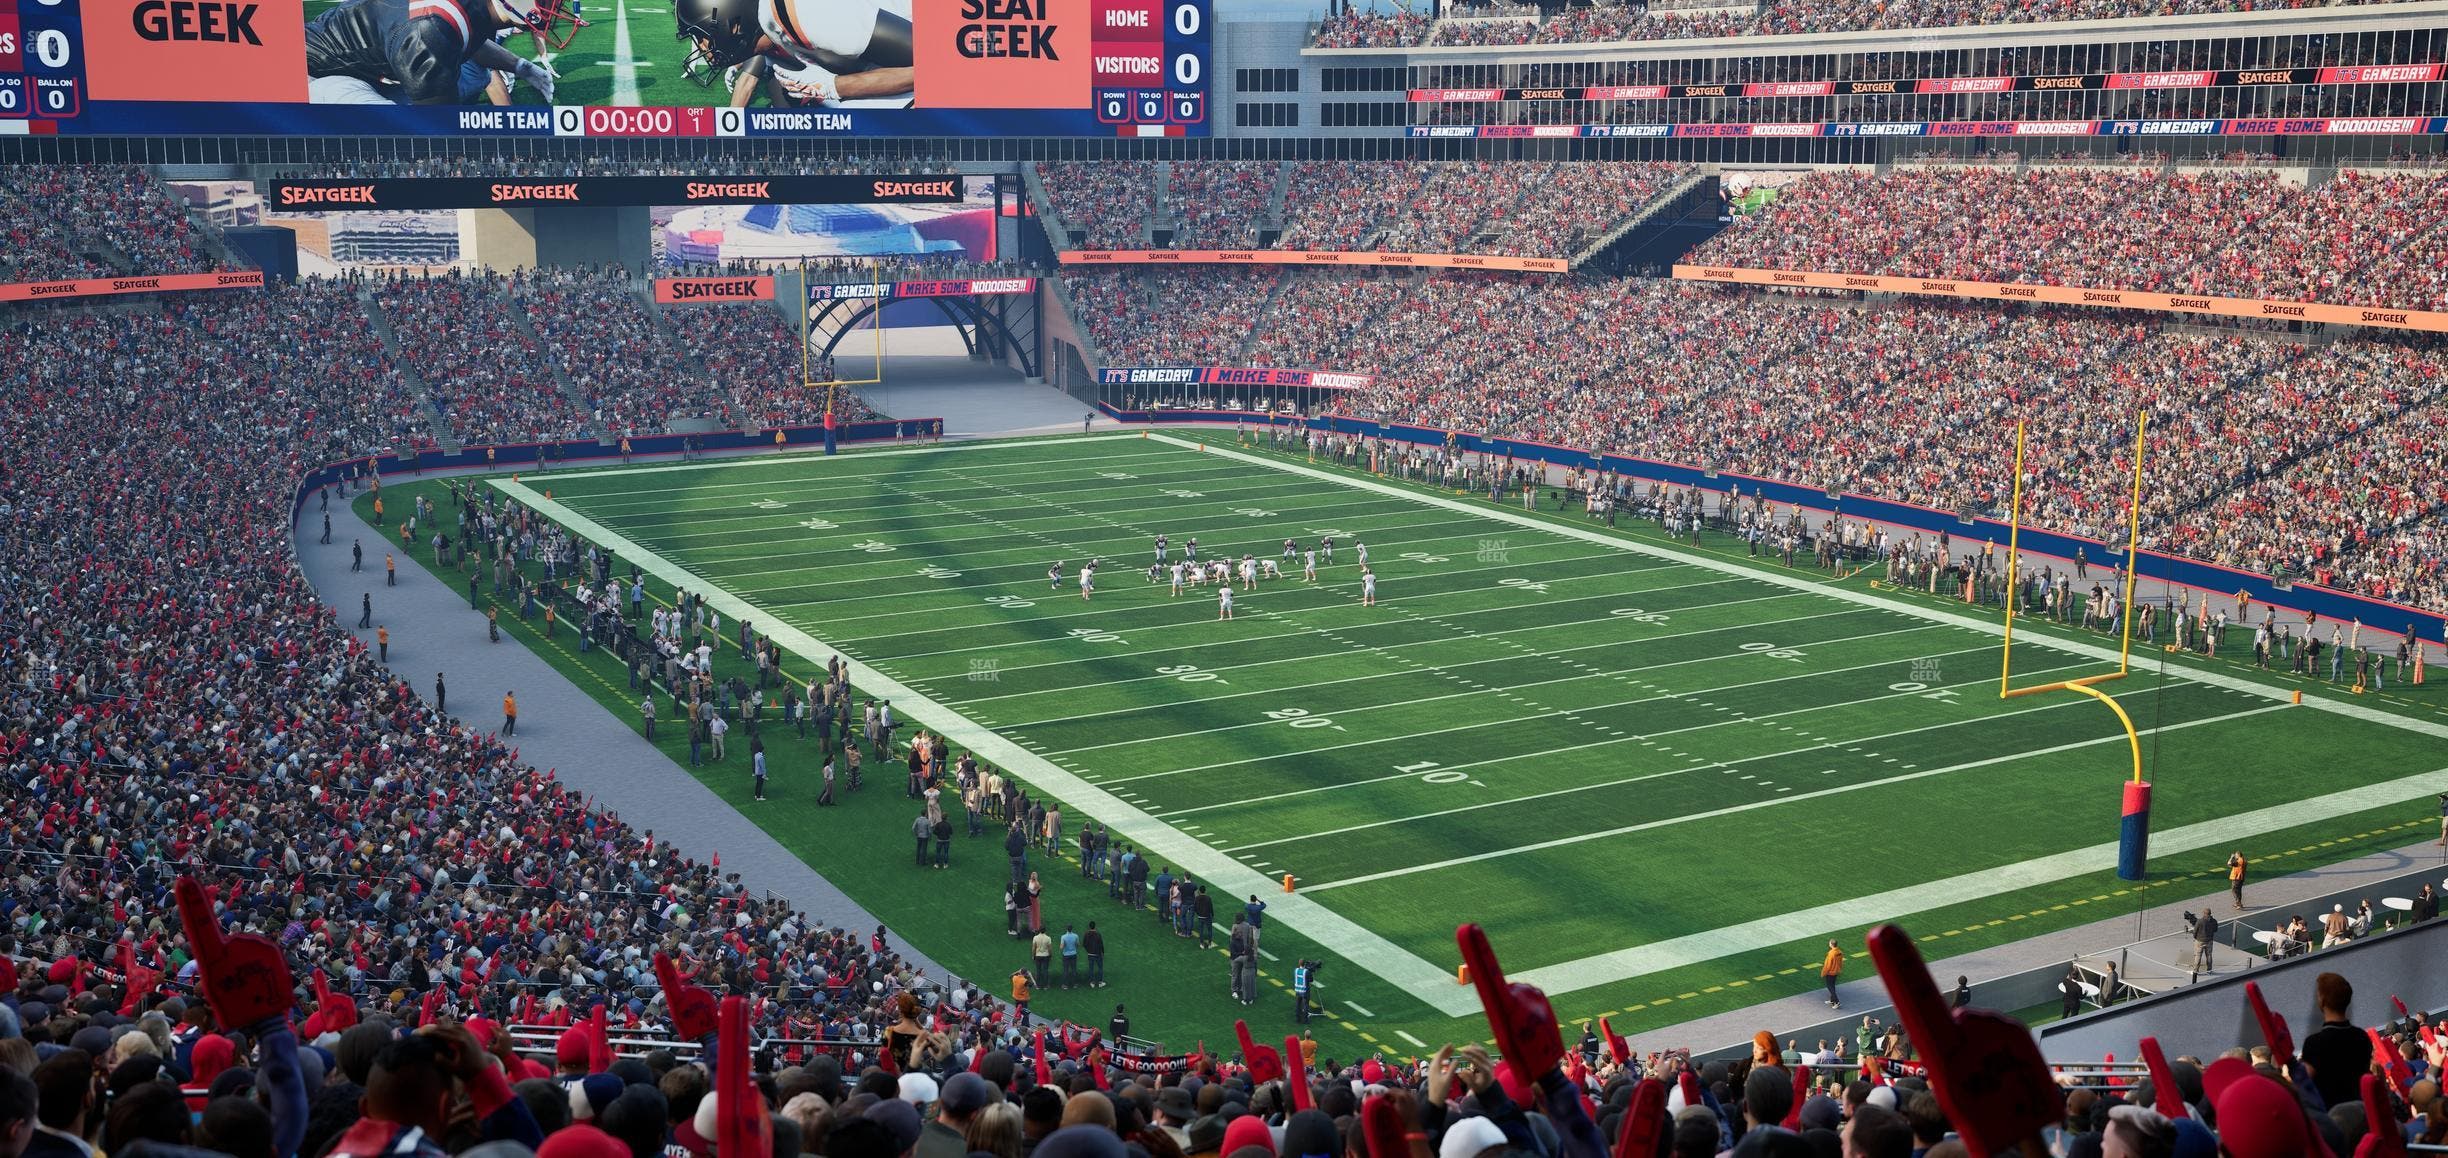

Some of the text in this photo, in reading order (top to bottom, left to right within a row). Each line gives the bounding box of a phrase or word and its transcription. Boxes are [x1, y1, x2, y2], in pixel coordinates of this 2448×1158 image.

[132, 0, 264, 47] GEEK
[1105, 9, 1149, 27] HOME
[1174, 3, 1200, 35] 0
[37, 29, 70, 68] 0
[956, 24, 1060, 61] GEEK
[1094, 56, 1160, 74] VISITORS
[1175, 53, 1201, 84] 0
[2143, 73, 2204, 86] GAMEDAY!
[2238, 71, 2292, 84] SEATGEEK
[2361, 67, 2431, 81] GAMEDAY!
[7, 78, 20, 86] GO
[38, 79, 73, 87] BALL ON
[1851, 82, 1896, 94] SEATGEEK
[1951, 79, 2005, 91] GAMEDAY!
[2033, 77, 2083, 89] SEATGEEK
[1443, 90, 1495, 101] GAMEDAY!
[1521, 88, 1565, 100] SEATGEEK
[1614, 87, 1660, 99] GAMEDAY!
[1685, 86, 1726, 97] SEATGEEK
[1776, 83, 1826, 95] GAMEDAY!
[0, 89, 16, 109] 0
[48, 90, 65, 109] 0
[687, 107, 705, 117] QRT
[1108, 101, 1120, 117] 0
[1144, 101, 1156, 117] 0
[1180, 101, 1192, 117] 0
[459, 111, 550, 130] HOME TEAM
[560, 109, 579, 132] 0
[590, 109, 673, 133] 00:00
[692, 118, 700, 133] 1
[722, 110, 740, 133] 0
[751, 113, 852, 130] VISITORS TEAM
[2234, 121, 2279, 132] MAKE
[2283, 120, 2325, 132] SOME
[1430, 127, 1475, 137] GAMEDAY!
[1612, 126, 1669, 136] GAMEDAY!
[1684, 126, 1715, 136] MAKE
[1719, 126, 1750, 135] SOME
[1834, 124, 1922, 135] IT'S GAMEDAY!
[1939, 124, 1975, 134] MAKE
[1981, 123, 2014, 134] SOME
[2111, 121, 2215, 134] IT'S GAMEDAY!
[281, 185, 377, 205] SEATGEEK
[491, 183, 580, 201] SEATGEEK
[687, 182, 771, 199] SEATGEEK
[874, 181, 956, 197] SEATGEEK
[1148, 253, 1180, 261] SEATGEEK
[1219, 253, 1254, 261] SEATGEEK
[1305, 254, 1339, 262] SEATGEEK
[1380, 255, 1413, 263] SEATGEEK
[1452, 257, 1484, 265] SEATGEEK
[1523, 261, 1555, 270] SEATGEEK
[217, 274, 262, 285] SEATGEEK
[1704, 270, 1734, 279] SEATGEEK
[1774, 274, 1805, 282] SEATGEEK
[112, 279, 161, 290] SEATGEEK
[905, 283, 937, 295] MAKE
[941, 282, 968, 294] SOME
[1846, 278, 1879, 287] SEATGEEK
[1921, 282, 1956, 292] SEATGEEK
[30, 284, 77, 295] SEATGEEK
[672, 280, 758, 299] SEATGEEK
[810, 286, 832, 299] IT'S
[1999, 287, 2036, 297] SEATGEEK
[2083, 292, 2121, 303] SEATGEEK
[2170, 298, 2211, 309] SEATGEEK
[2262, 304, 2305, 316] SEATGEEK
[2361, 312, 2408, 324] SEATGEEK
[1105, 369, 1194, 382] IT'S GAMEDAY!
[1216, 369, 1270, 384] MAKE
[1276, 371, 1309, 385] SOME
[984, 595, 1036, 608] 50
[1066, 629, 1121, 642] 40
[1156, 665, 1218, 682] 30
[1262, 708, 1333, 728] 20
[1392, 761, 1469, 783] 10
[1110, 1053, 1135, 1070] LET'S
[1888, 1061, 1915, 1076] LET'S
